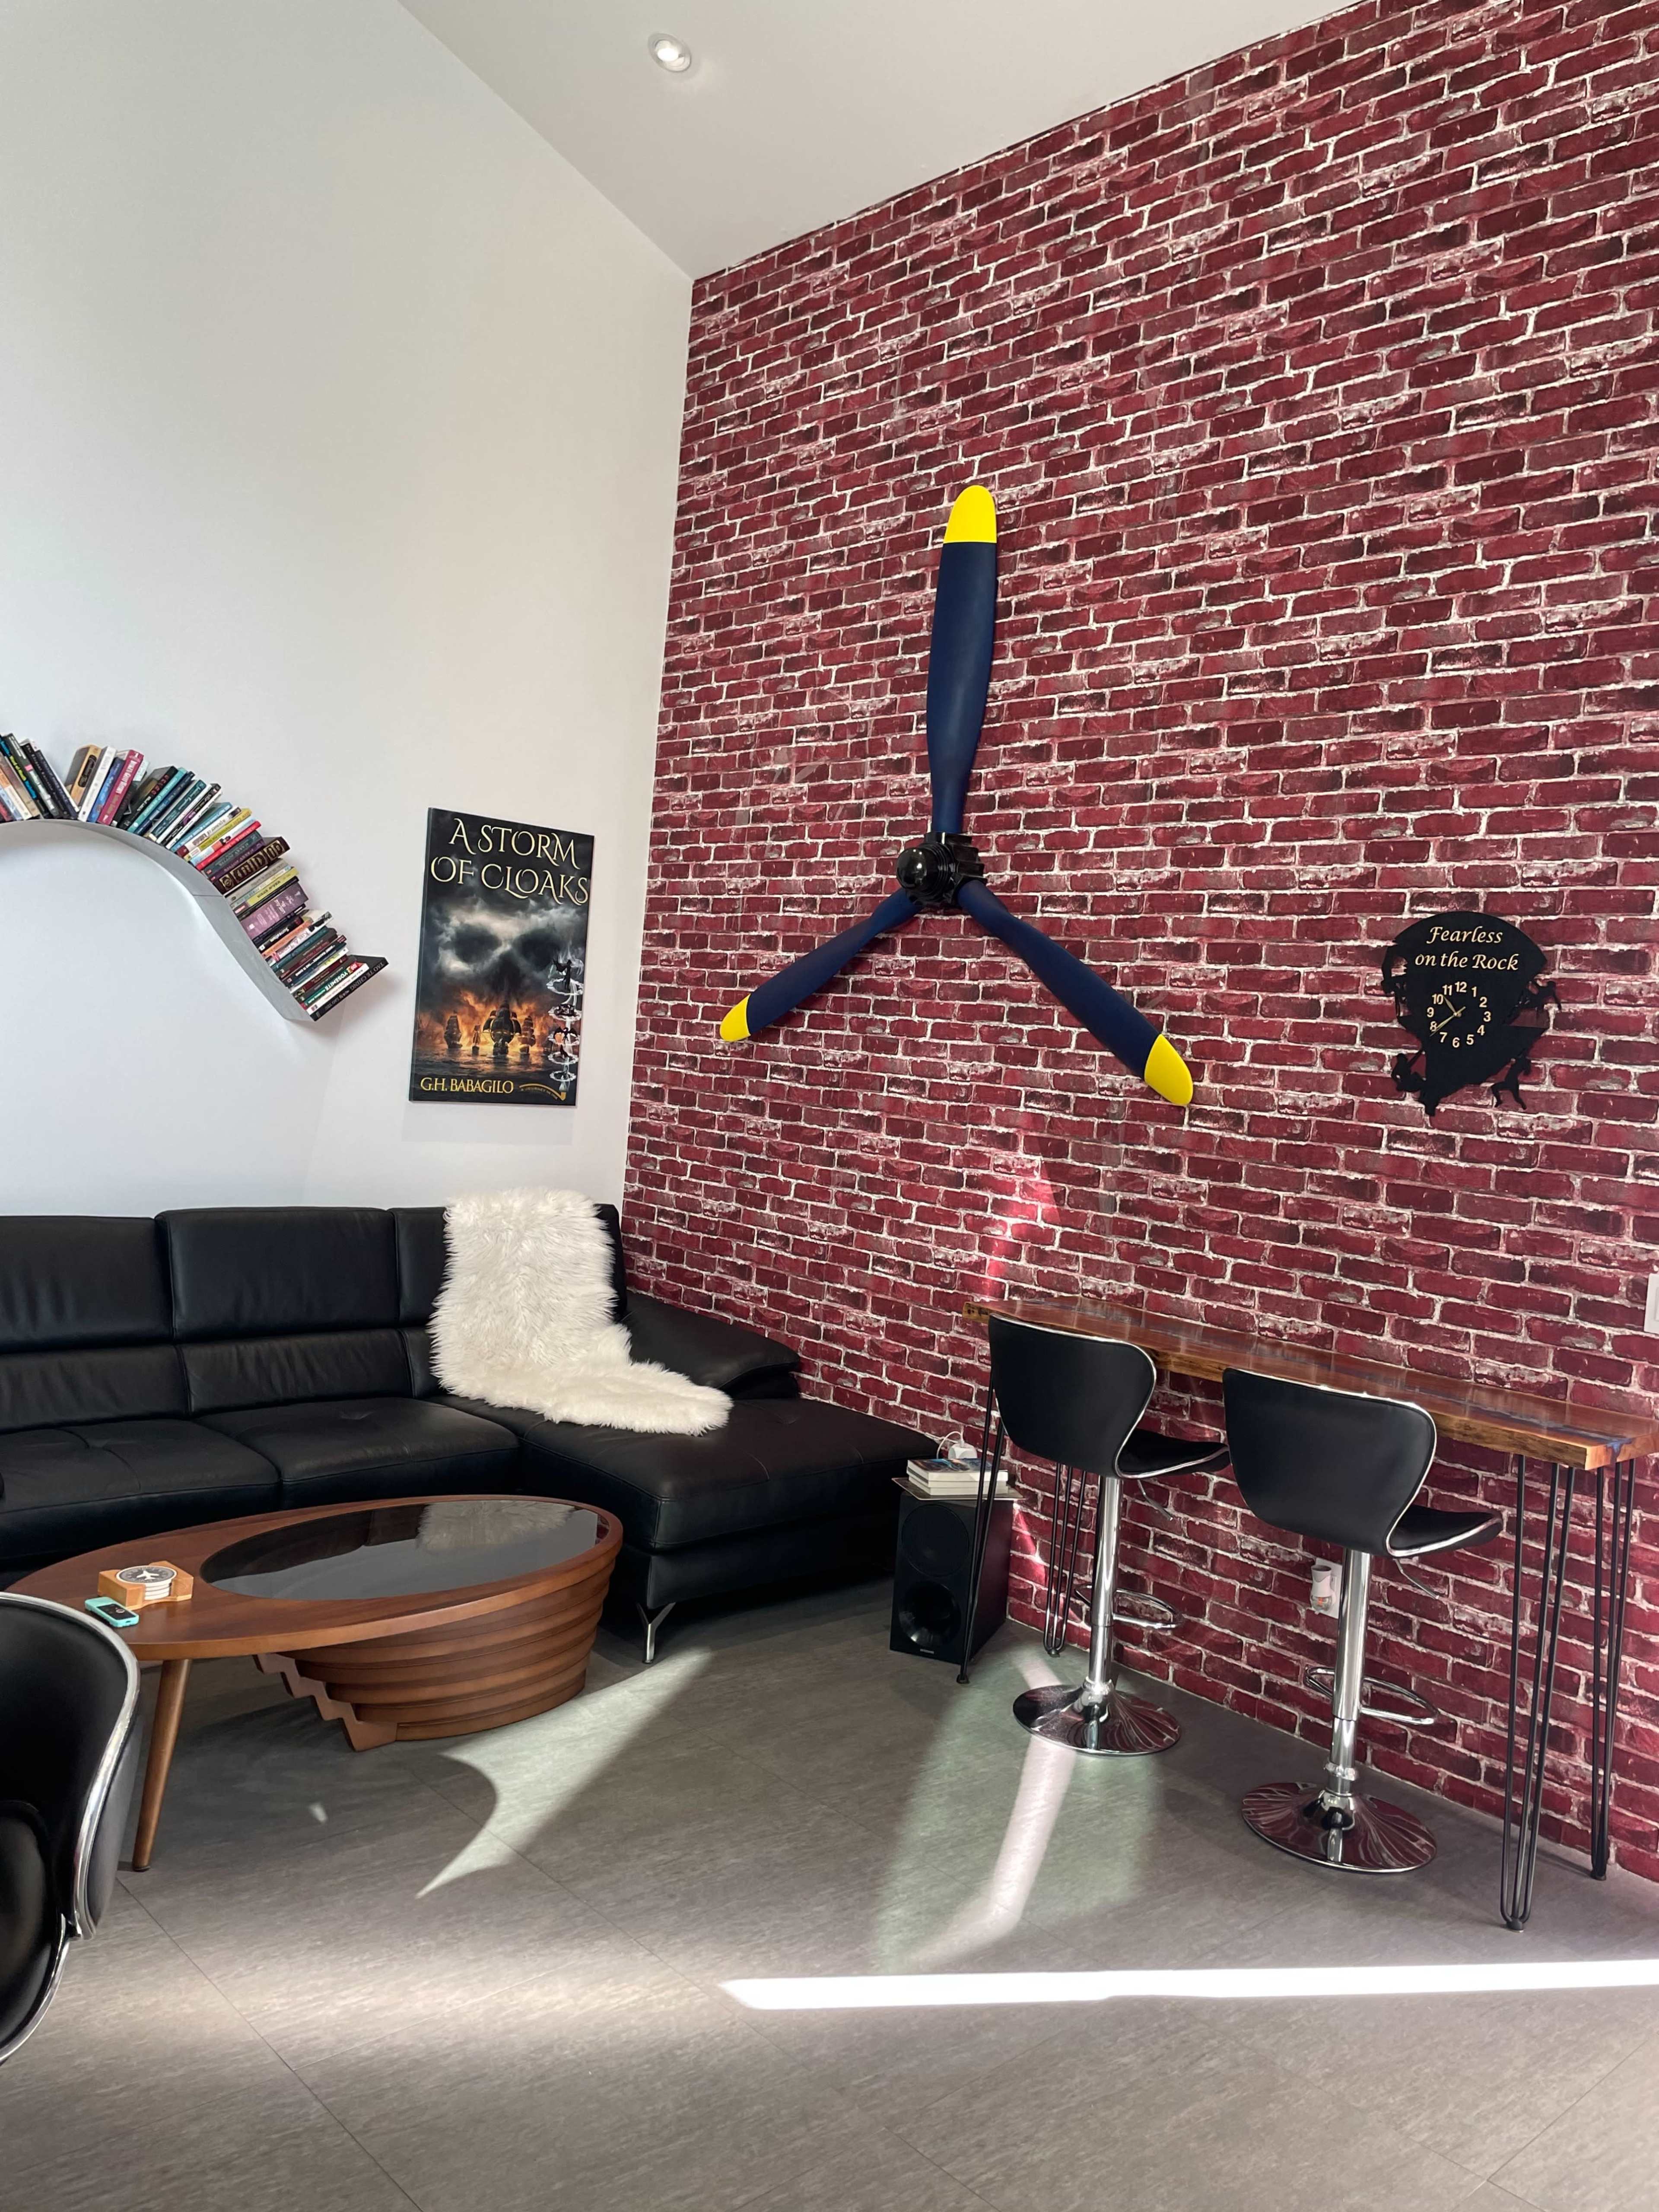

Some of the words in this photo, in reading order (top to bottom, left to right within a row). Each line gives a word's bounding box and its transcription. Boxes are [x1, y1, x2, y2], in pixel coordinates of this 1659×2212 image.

[449, 818, 477, 855] A
[478, 824, 580, 870] STORM
[431, 856, 475, 884] OF
[481, 863, 589, 906] CLOAKS
[1427, 926, 1503, 944] Fearless
[1415, 954, 1436, 966] on
[1439, 951, 1468, 968] the
[1472, 953, 1519, 971] Rock
[372, 961, 385, 973] TAO
[365, 969, 374, 978] TE
[324, 970, 349, 991] YOSEMITE
[349, 975, 367, 991] CHING
[1443, 985, 1452, 995] 11
[1455, 981, 1467, 993] 12
[1471, 986, 1477, 997] 1
[1432, 993, 1443, 1004] 10
[1480, 997, 1488, 1007] 2
[1427, 1007, 1434, 1017] 9
[1483, 1011, 1491, 1022] 3
[1430, 1021, 1437, 1032] 8
[1477, 1025, 1485, 1036] 4
[1440, 1032, 1448, 1043] 7
[1452, 1037, 1460, 1049] 6
[1466, 1034, 1474, 1045] 5
[420, 1077, 448, 1092] G.H.
[450, 1078, 514, 1094] BABAGILO
